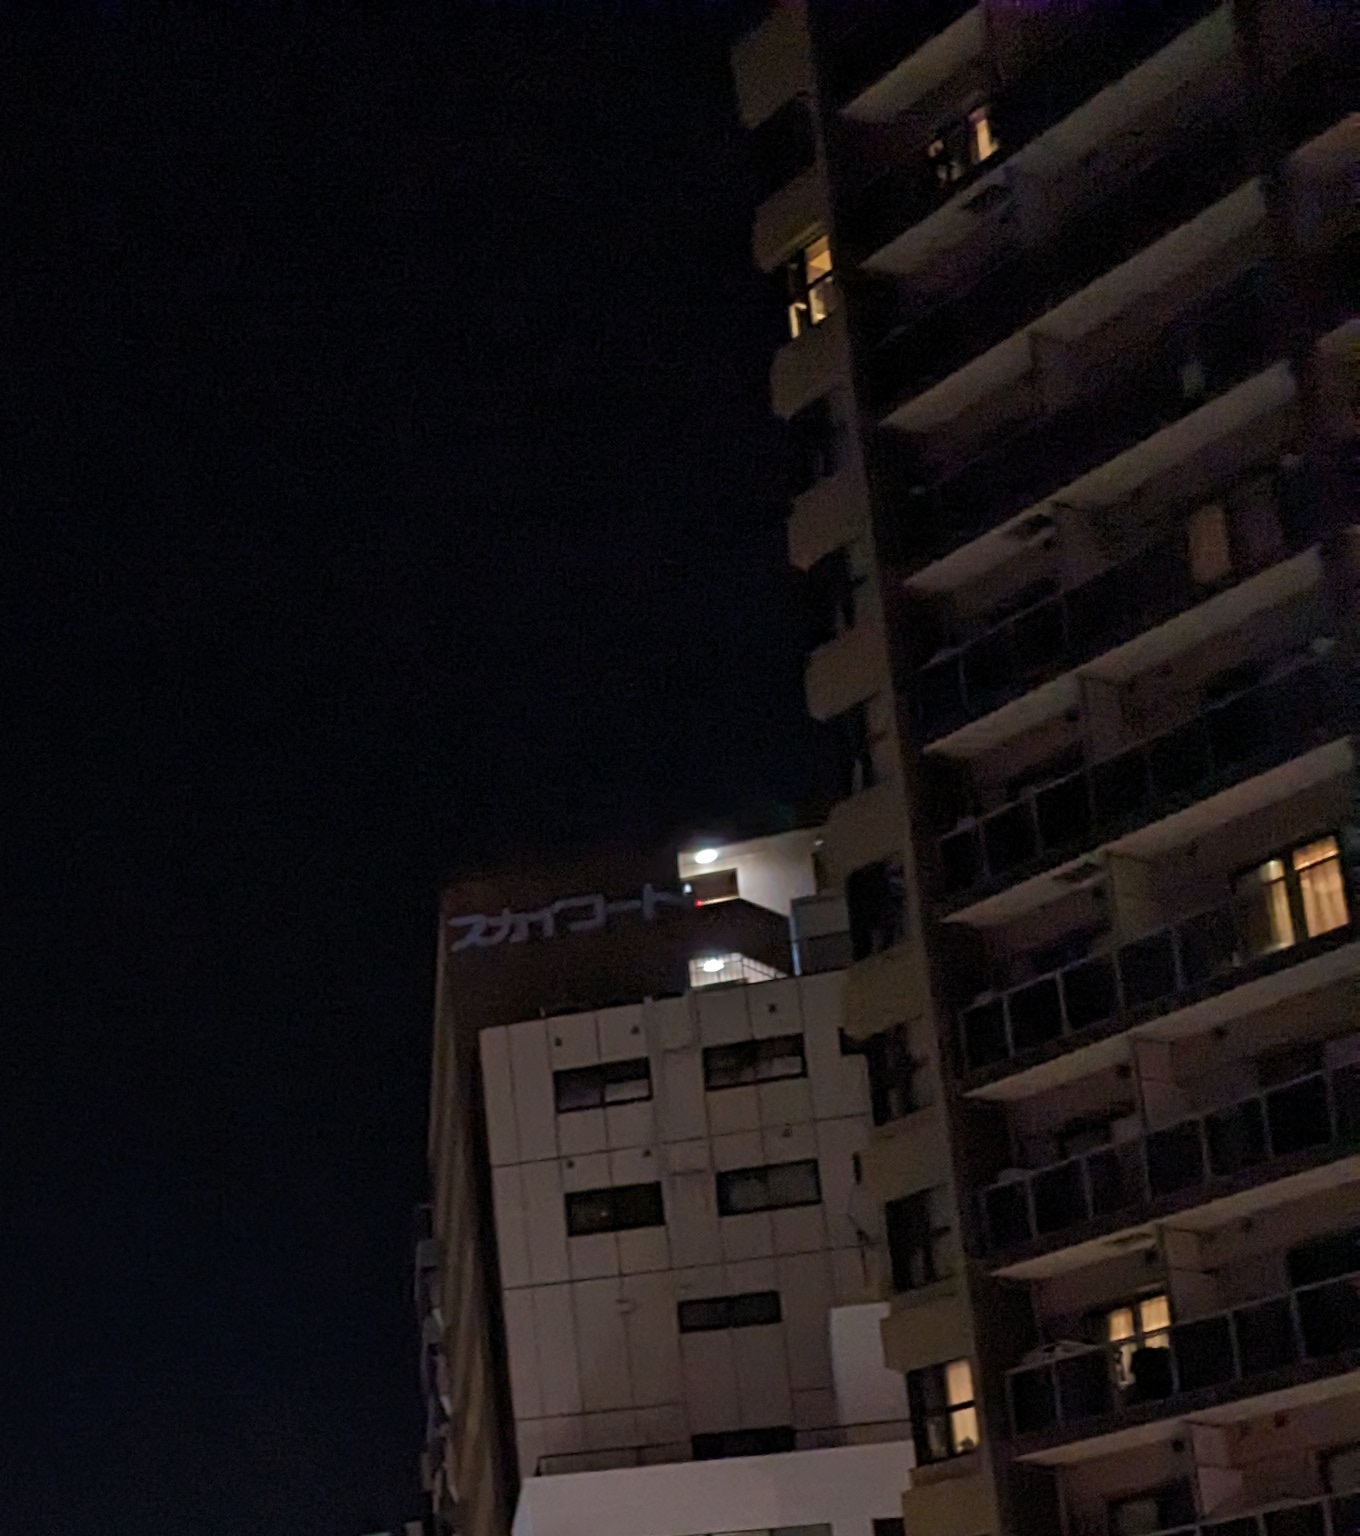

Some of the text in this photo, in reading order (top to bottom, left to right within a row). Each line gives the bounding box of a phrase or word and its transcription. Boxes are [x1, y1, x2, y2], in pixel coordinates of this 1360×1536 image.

[448, 883, 683, 952] スカイコート
